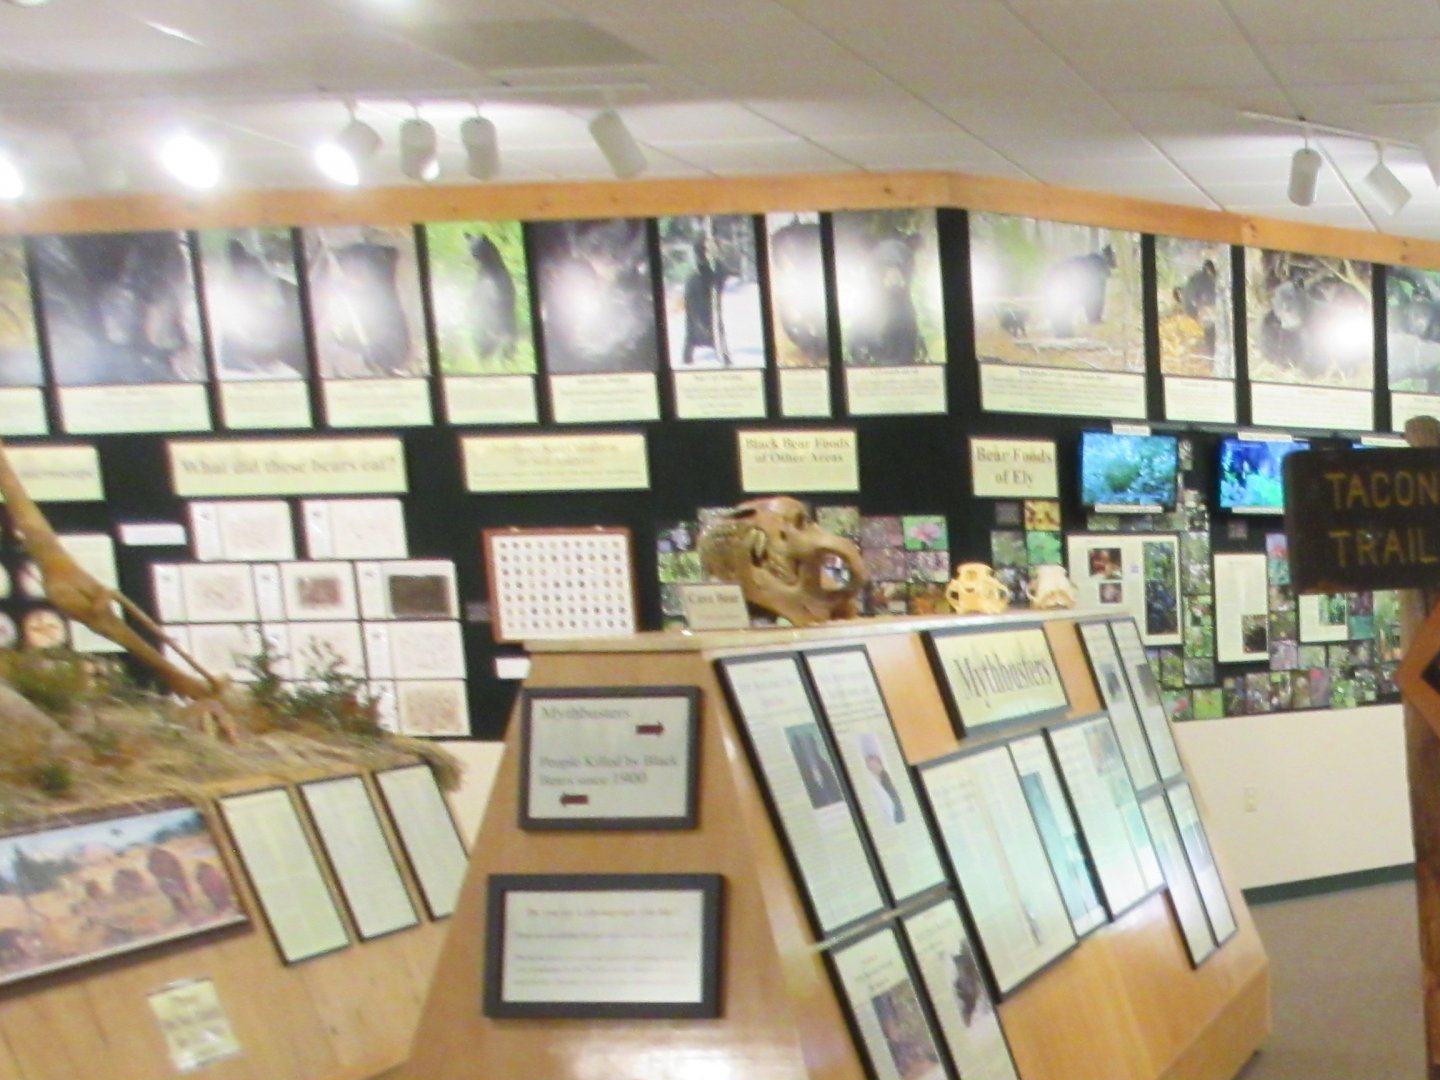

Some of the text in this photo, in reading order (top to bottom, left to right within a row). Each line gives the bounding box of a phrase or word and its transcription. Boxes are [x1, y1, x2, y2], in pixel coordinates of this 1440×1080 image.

[976, 446, 1052, 464] Bear Foods
[995, 470, 1035, 488] of Ely
[1328, 527, 1439, 568] TRAIL
[953, 650, 1053, 710] Mythbusters
[542, 706, 631, 721] Mythbusters
